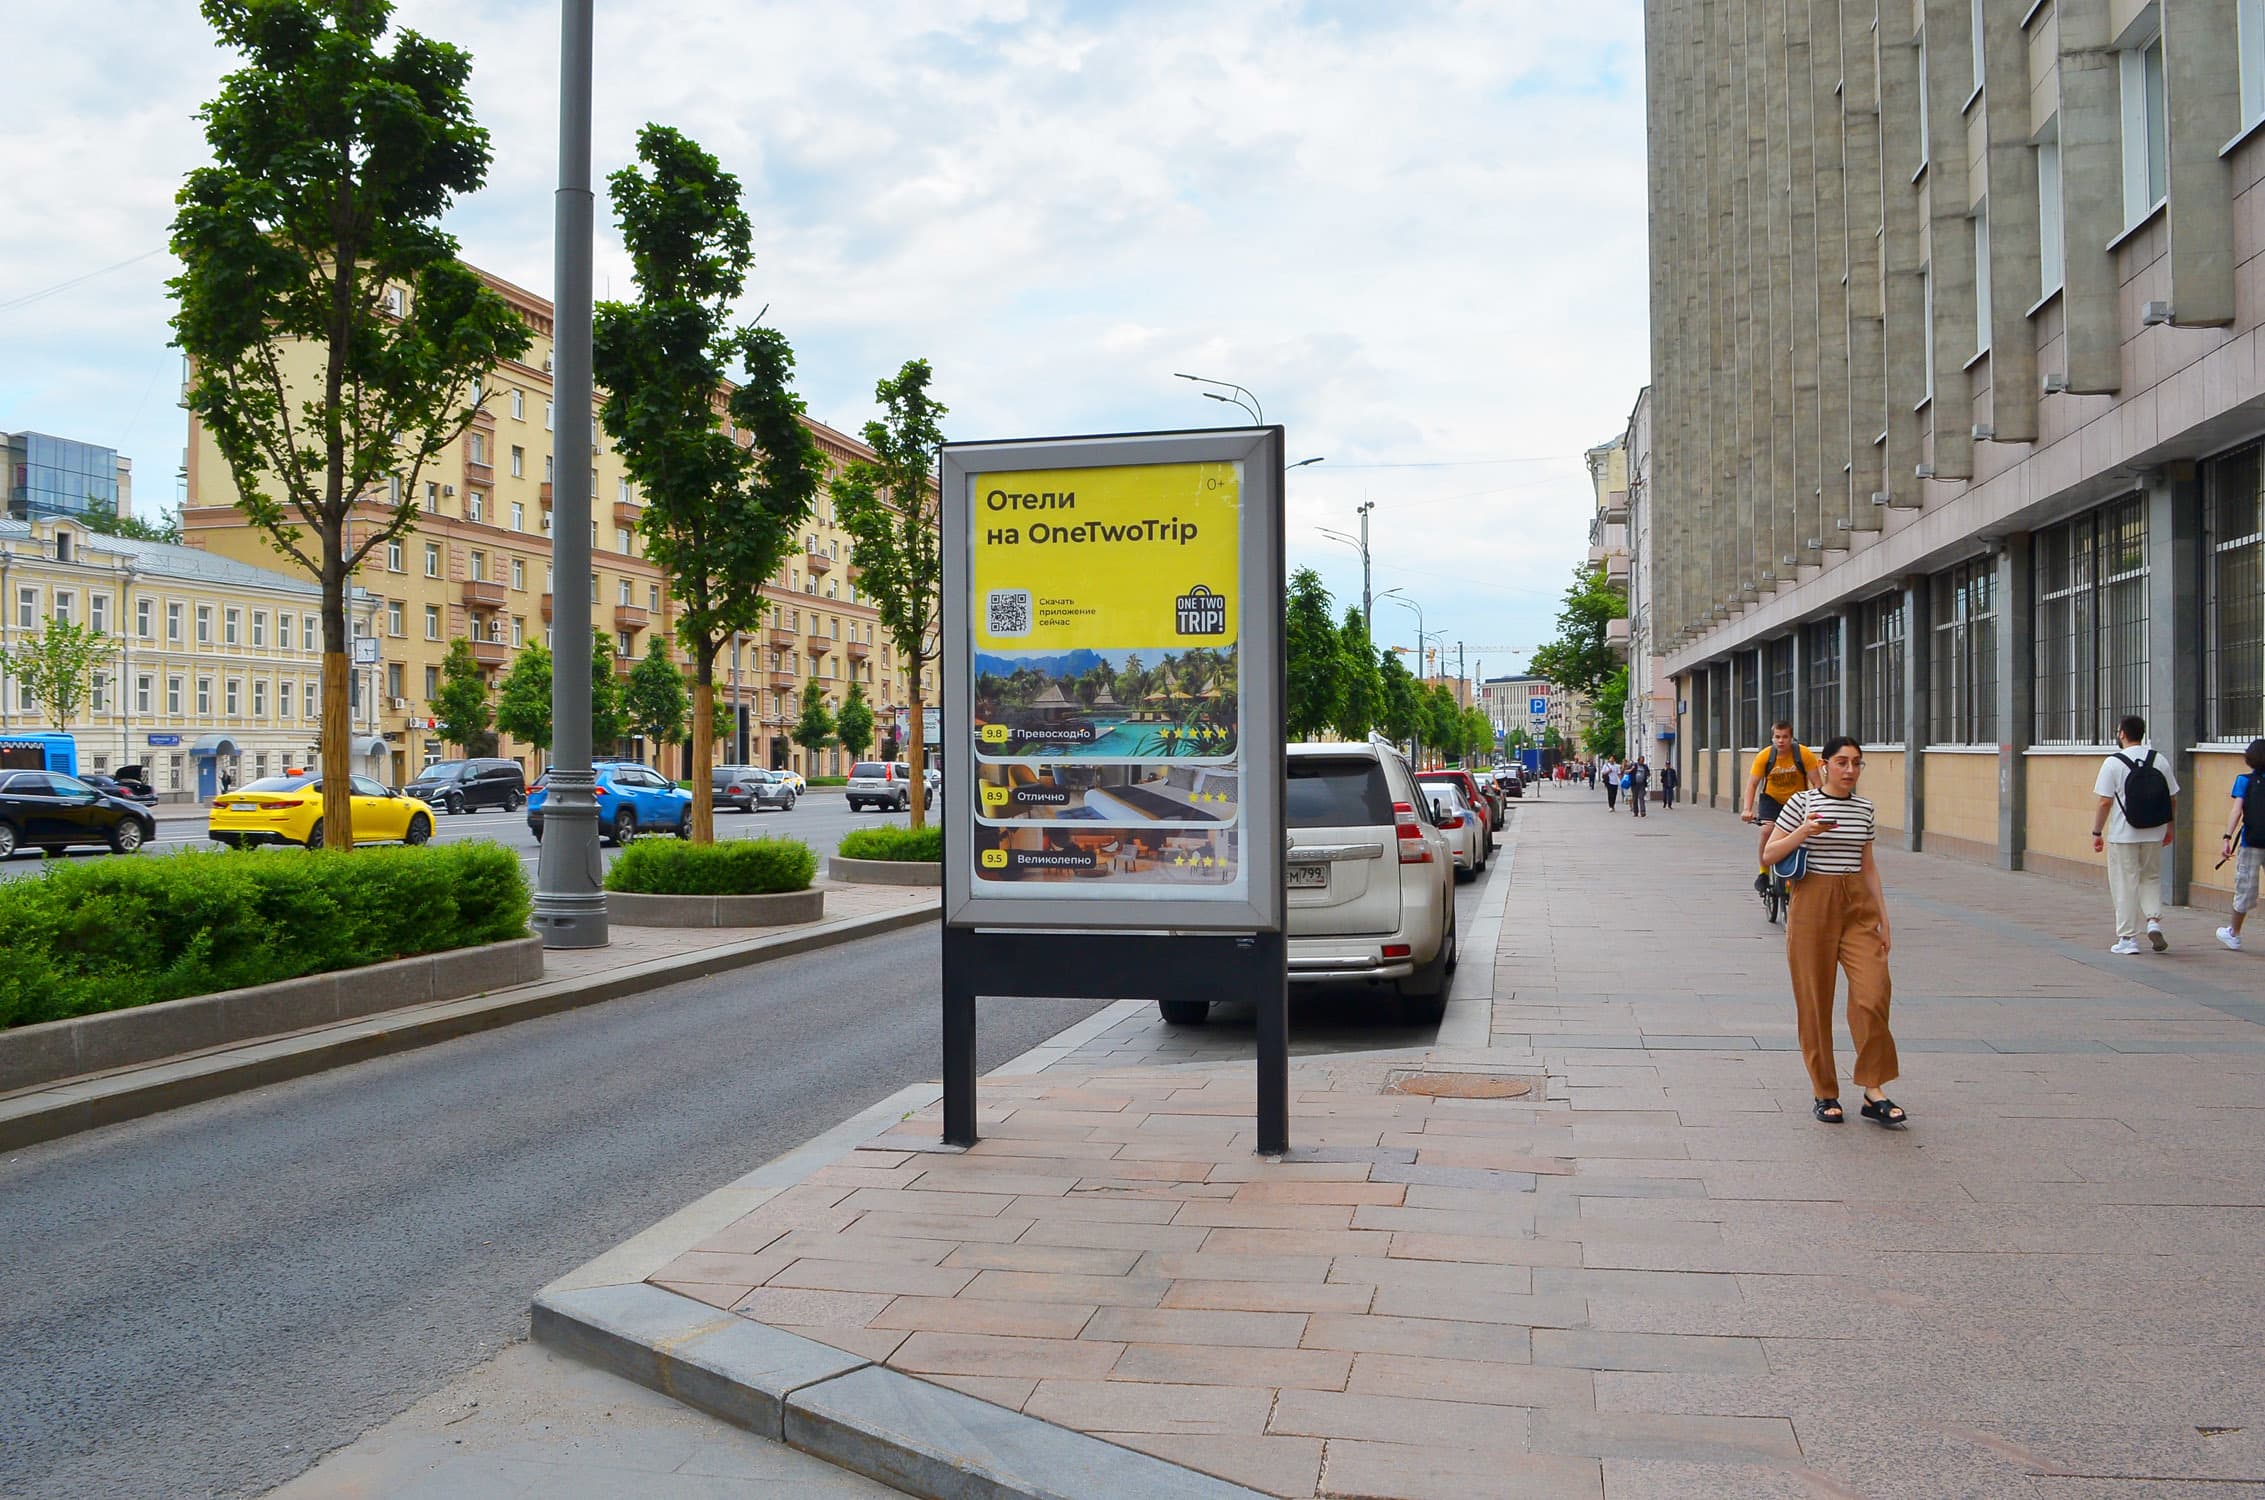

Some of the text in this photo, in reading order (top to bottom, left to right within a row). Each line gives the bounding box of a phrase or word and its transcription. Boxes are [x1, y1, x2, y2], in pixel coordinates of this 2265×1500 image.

[986, 489, 1075, 511] Отели
[987, 516, 1198, 545] на OneTwoTrip
[1177, 597, 1224, 610] ONE TWO
[1039, 608, 1096, 617] приложение
[1039, 618, 1071, 626] сейчас
[1177, 610, 1224, 633] TRIP!
[986, 729, 1091, 740] 9.8 Превосходно
[986, 791, 1065, 801] 8.9 Отлично
[986, 854, 1092, 865] 9.5 Великолепно
[1302, 867, 1322, 879] 799
